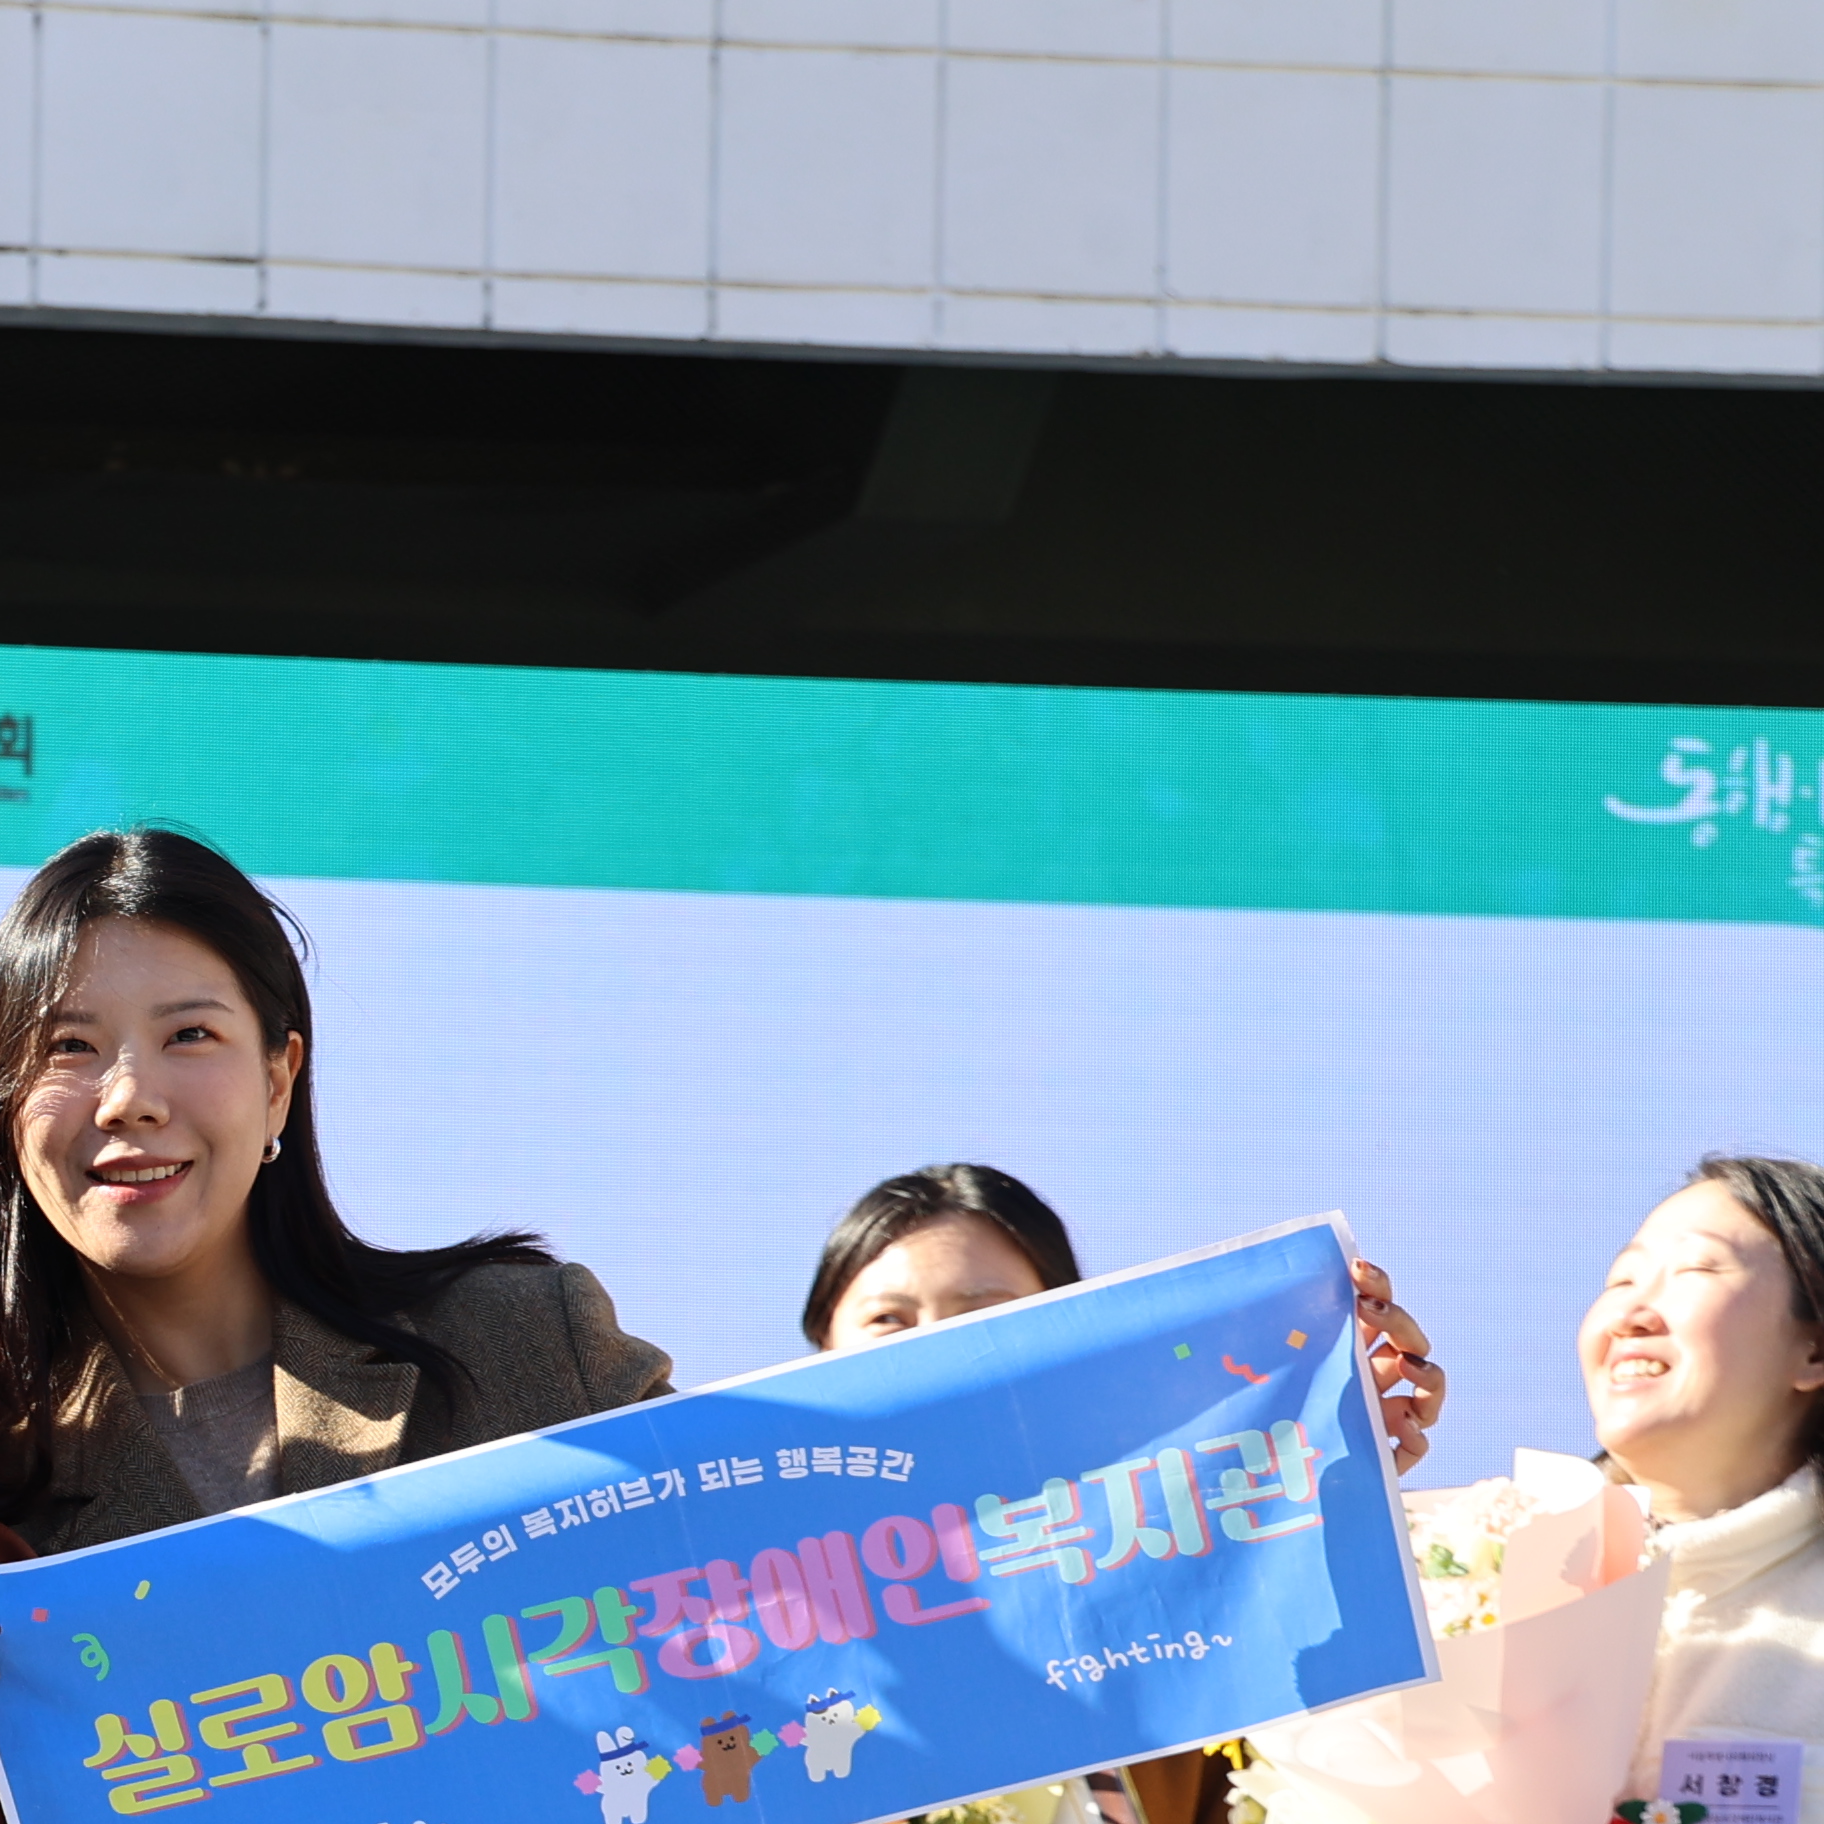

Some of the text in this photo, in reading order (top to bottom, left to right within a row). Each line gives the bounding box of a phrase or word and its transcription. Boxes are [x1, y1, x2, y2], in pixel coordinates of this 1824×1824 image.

[83, 1420, 1323, 1816] 실로암시각장애인복지관
[421, 1444, 915, 1601] 모두의 복지허브가 되는 행복공간
